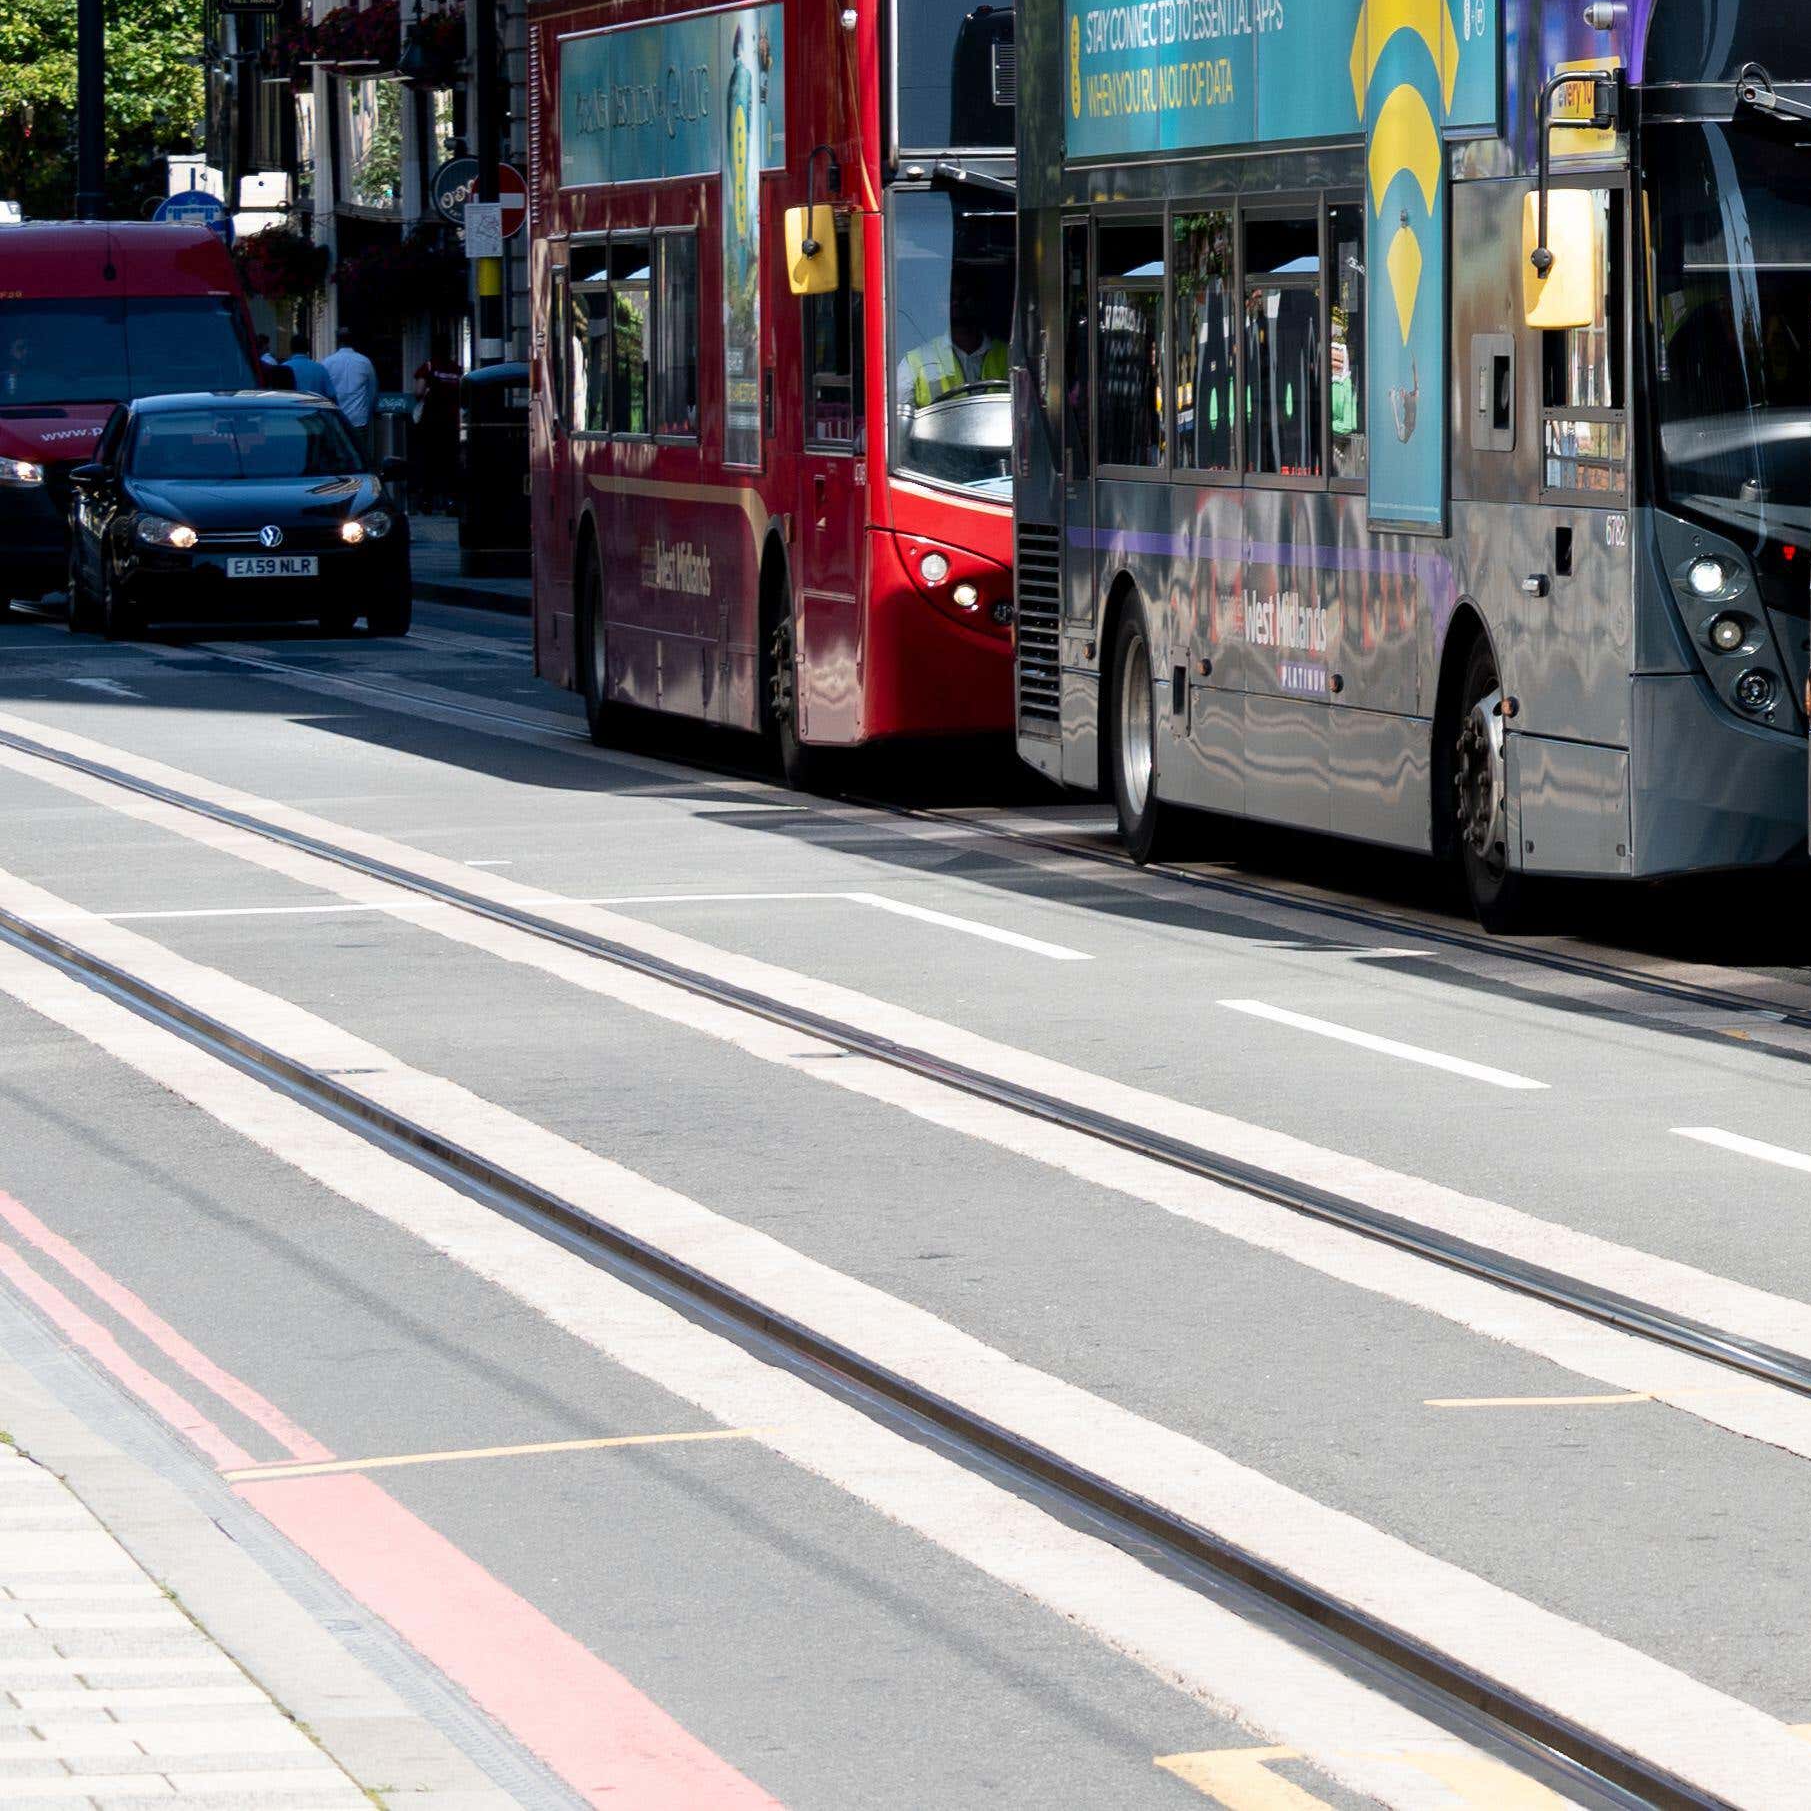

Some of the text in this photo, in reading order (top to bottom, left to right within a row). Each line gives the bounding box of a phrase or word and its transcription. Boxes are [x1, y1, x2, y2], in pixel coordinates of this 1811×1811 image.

[1086, 8, 1110, 54] STAY
[1110, 0, 1176, 51] CONNECTED
[1086, 58, 1235, 118] WHEN YOU RUN OUT OF DATA
[234, 559, 311, 575] EA59 NLR
[1243, 589, 1275, 645] West
[1276, 591, 1327, 652] Midlands
